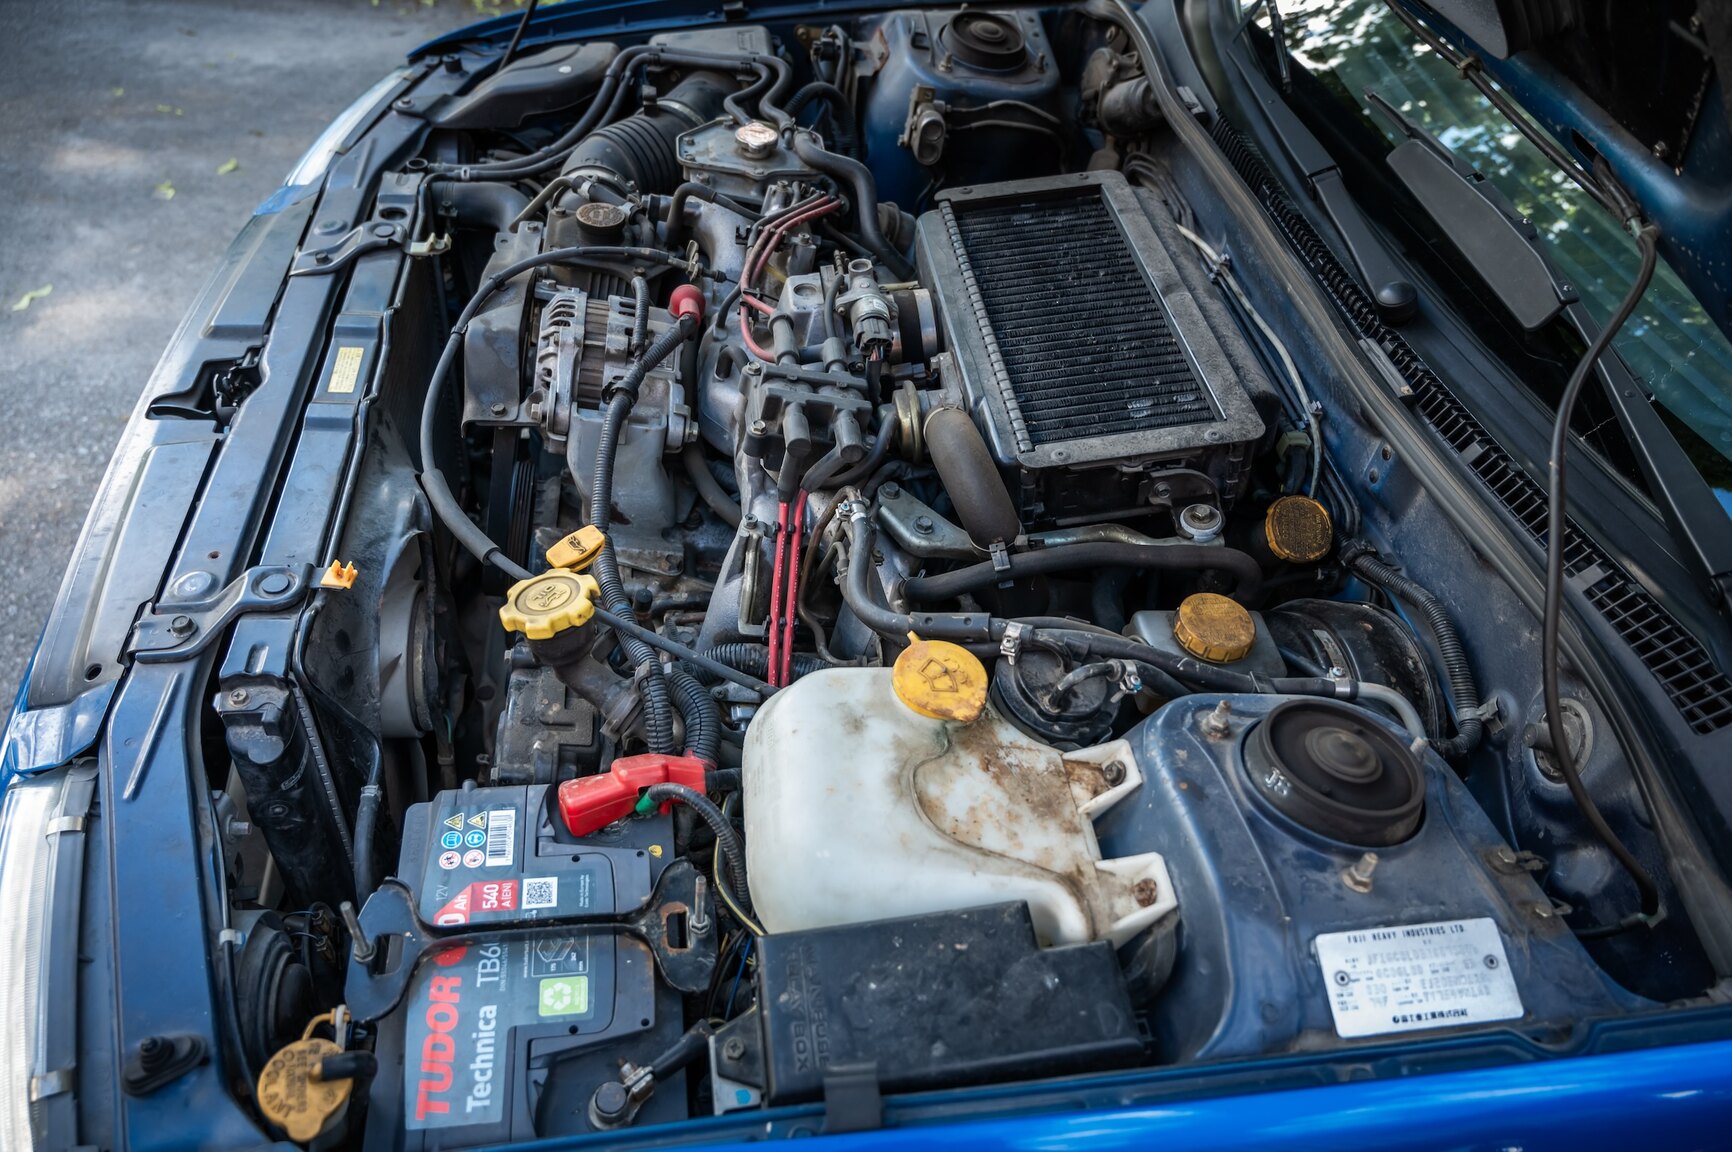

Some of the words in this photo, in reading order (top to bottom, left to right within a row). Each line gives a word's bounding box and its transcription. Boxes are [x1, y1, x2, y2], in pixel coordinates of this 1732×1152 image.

[435, 884, 448, 901] 12V
[453, 894, 468, 911] Ah
[482, 883, 499, 909] 540
[1403, 925, 1446, 938] INDUSTRIES
[415, 976, 462, 1121] TUDOR
[466, 1004, 498, 1113] Technica
[790, 1021, 811, 1074] BOX
